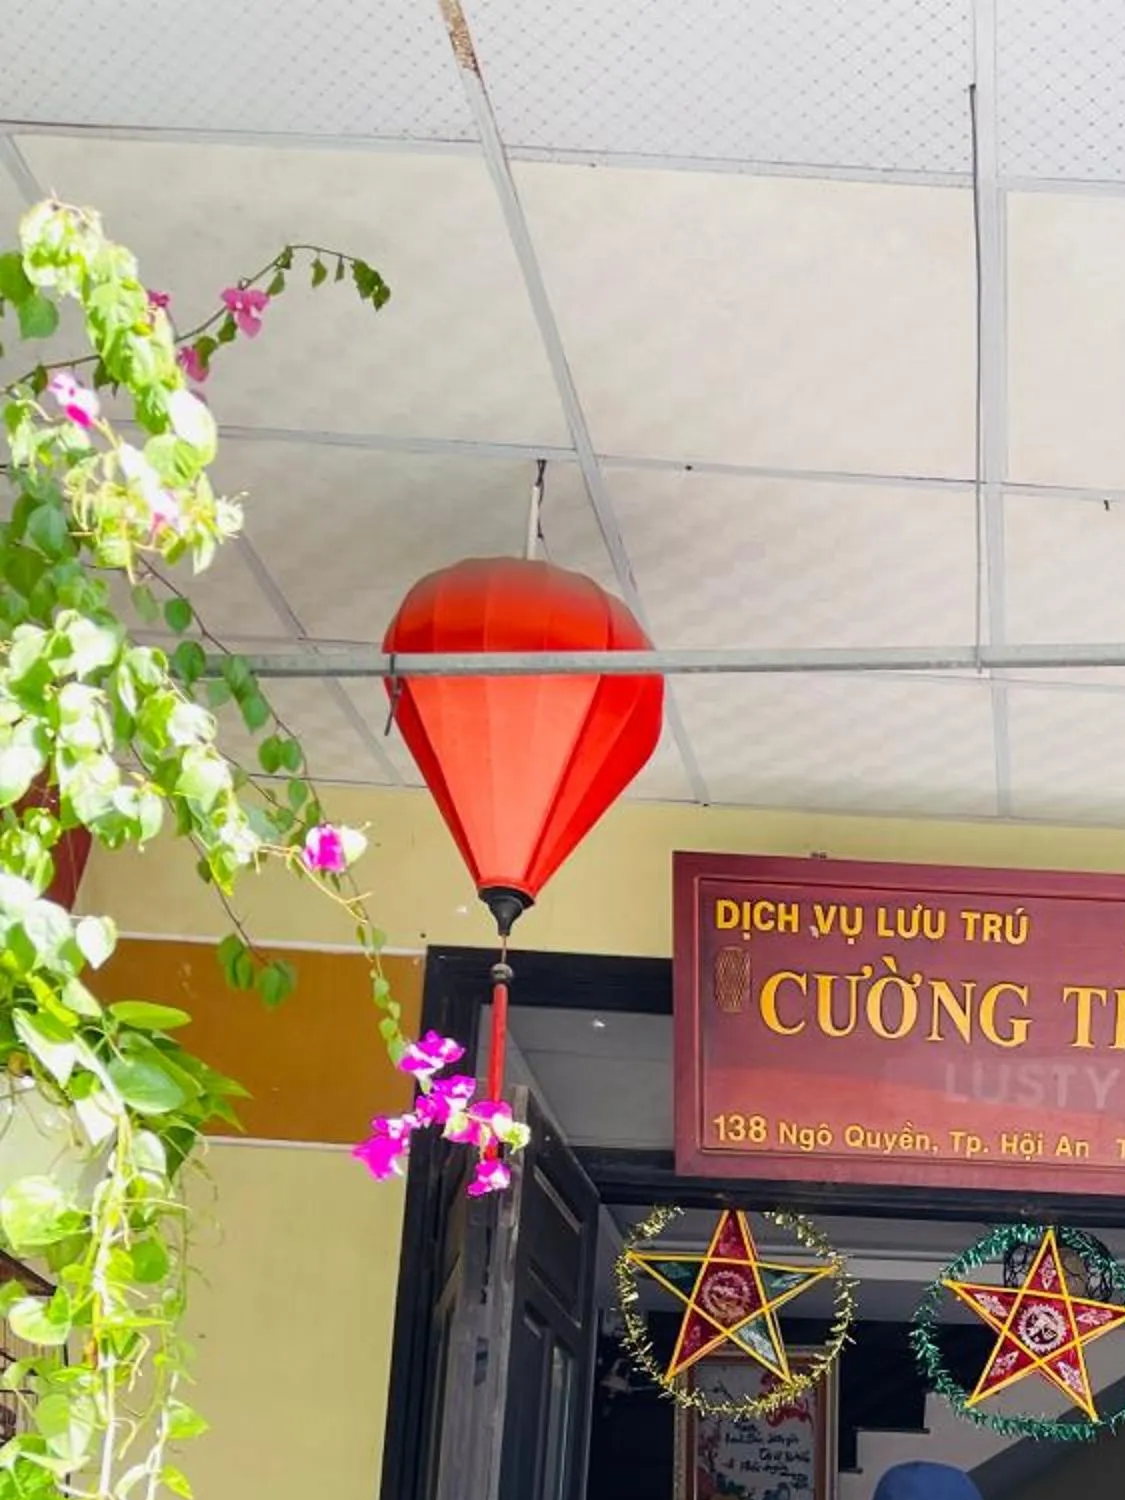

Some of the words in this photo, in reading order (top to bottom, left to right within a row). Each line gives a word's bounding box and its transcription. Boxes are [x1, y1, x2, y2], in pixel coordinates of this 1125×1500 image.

[715, 899, 799, 941] DỊCH
[813, 905, 863, 945] VỤ
[877, 904, 946, 940] LƯU
[961, 907, 1029, 945] TRÚ
[759, 956, 1033, 1048] CƯỜNG
[713, 1114, 767, 1143] 138
[779, 1122, 833, 1151] Ngô
[950, 1131, 989, 1158] Tp.
[1001, 1131, 1043, 1161] Hội
[1056, 1133, 1090, 1158] An
